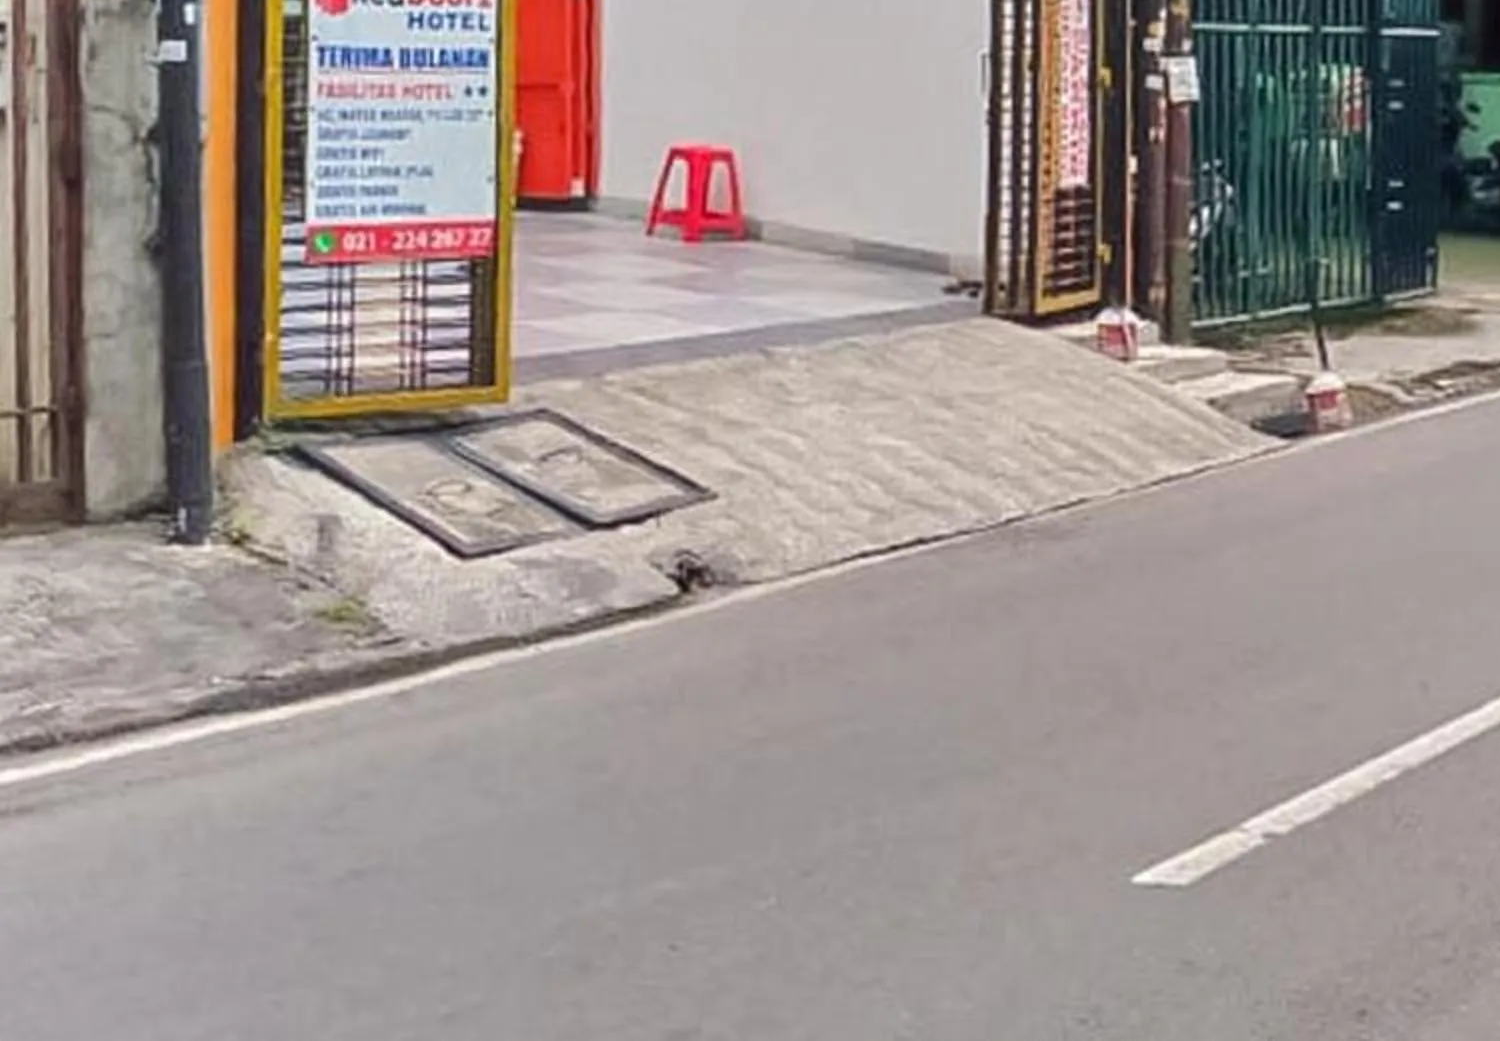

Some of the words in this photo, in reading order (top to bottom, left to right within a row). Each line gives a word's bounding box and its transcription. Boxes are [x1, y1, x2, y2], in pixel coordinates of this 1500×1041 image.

[408, 11, 491, 33] HOTEL
[317, 45, 394, 68] TERIMA
[399, 45, 489, 69] BULANAN
